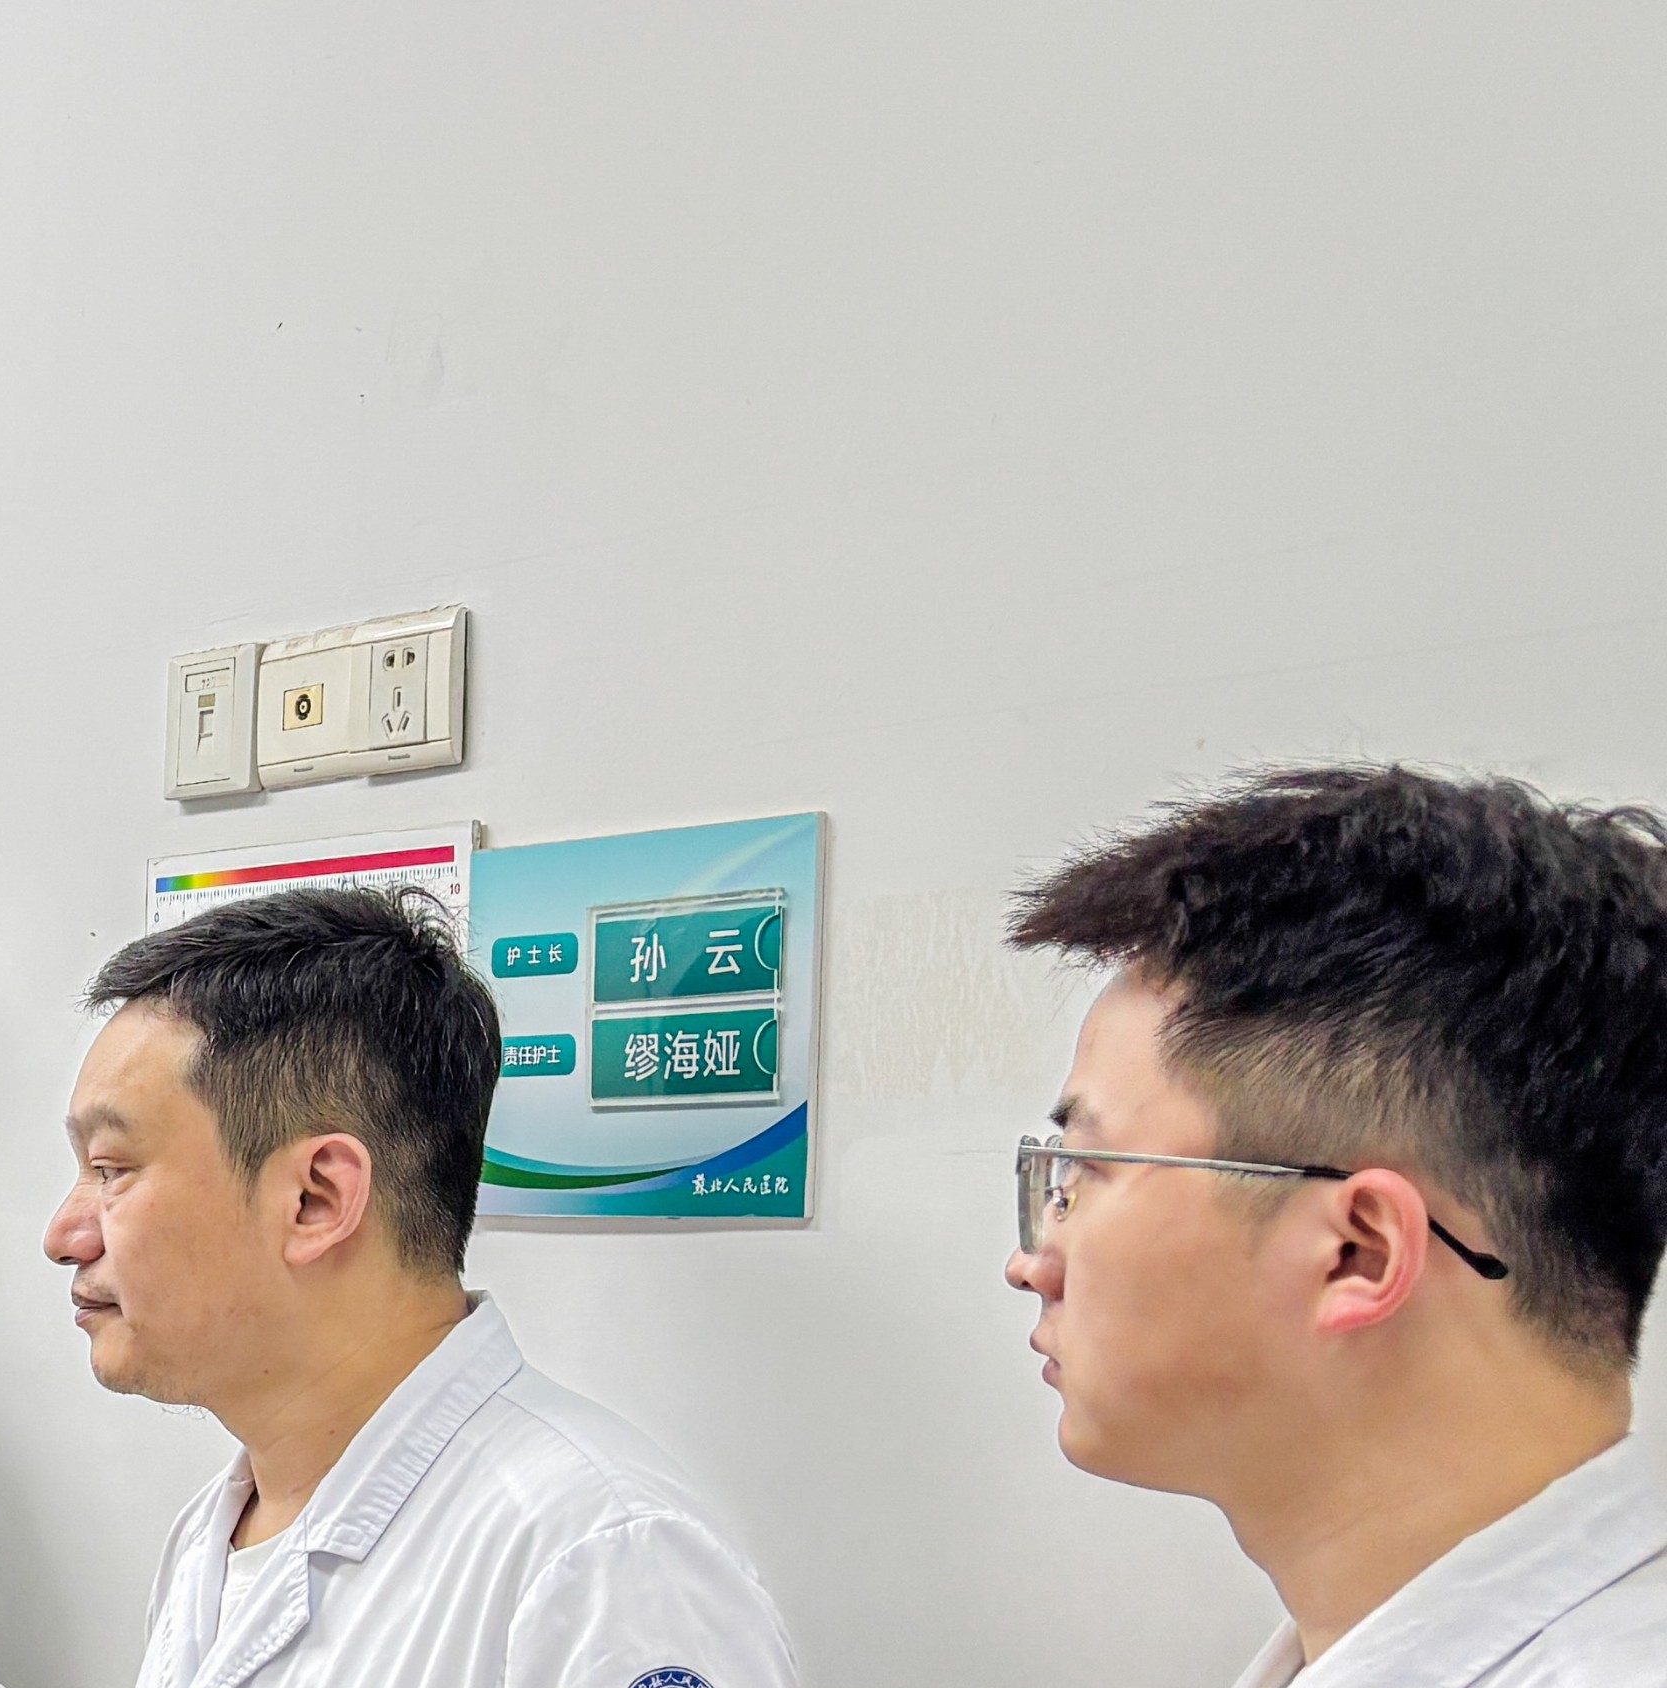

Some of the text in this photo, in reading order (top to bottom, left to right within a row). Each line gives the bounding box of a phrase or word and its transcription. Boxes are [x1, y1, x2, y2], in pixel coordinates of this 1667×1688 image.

[450, 883, 461, 895] 10
[153, 912, 160, 924] 0
[507, 943, 563, 967] 护士长
[503, 1045, 562, 1067] 责任护士
[623, 1029, 742, 1083] 缪海娅
